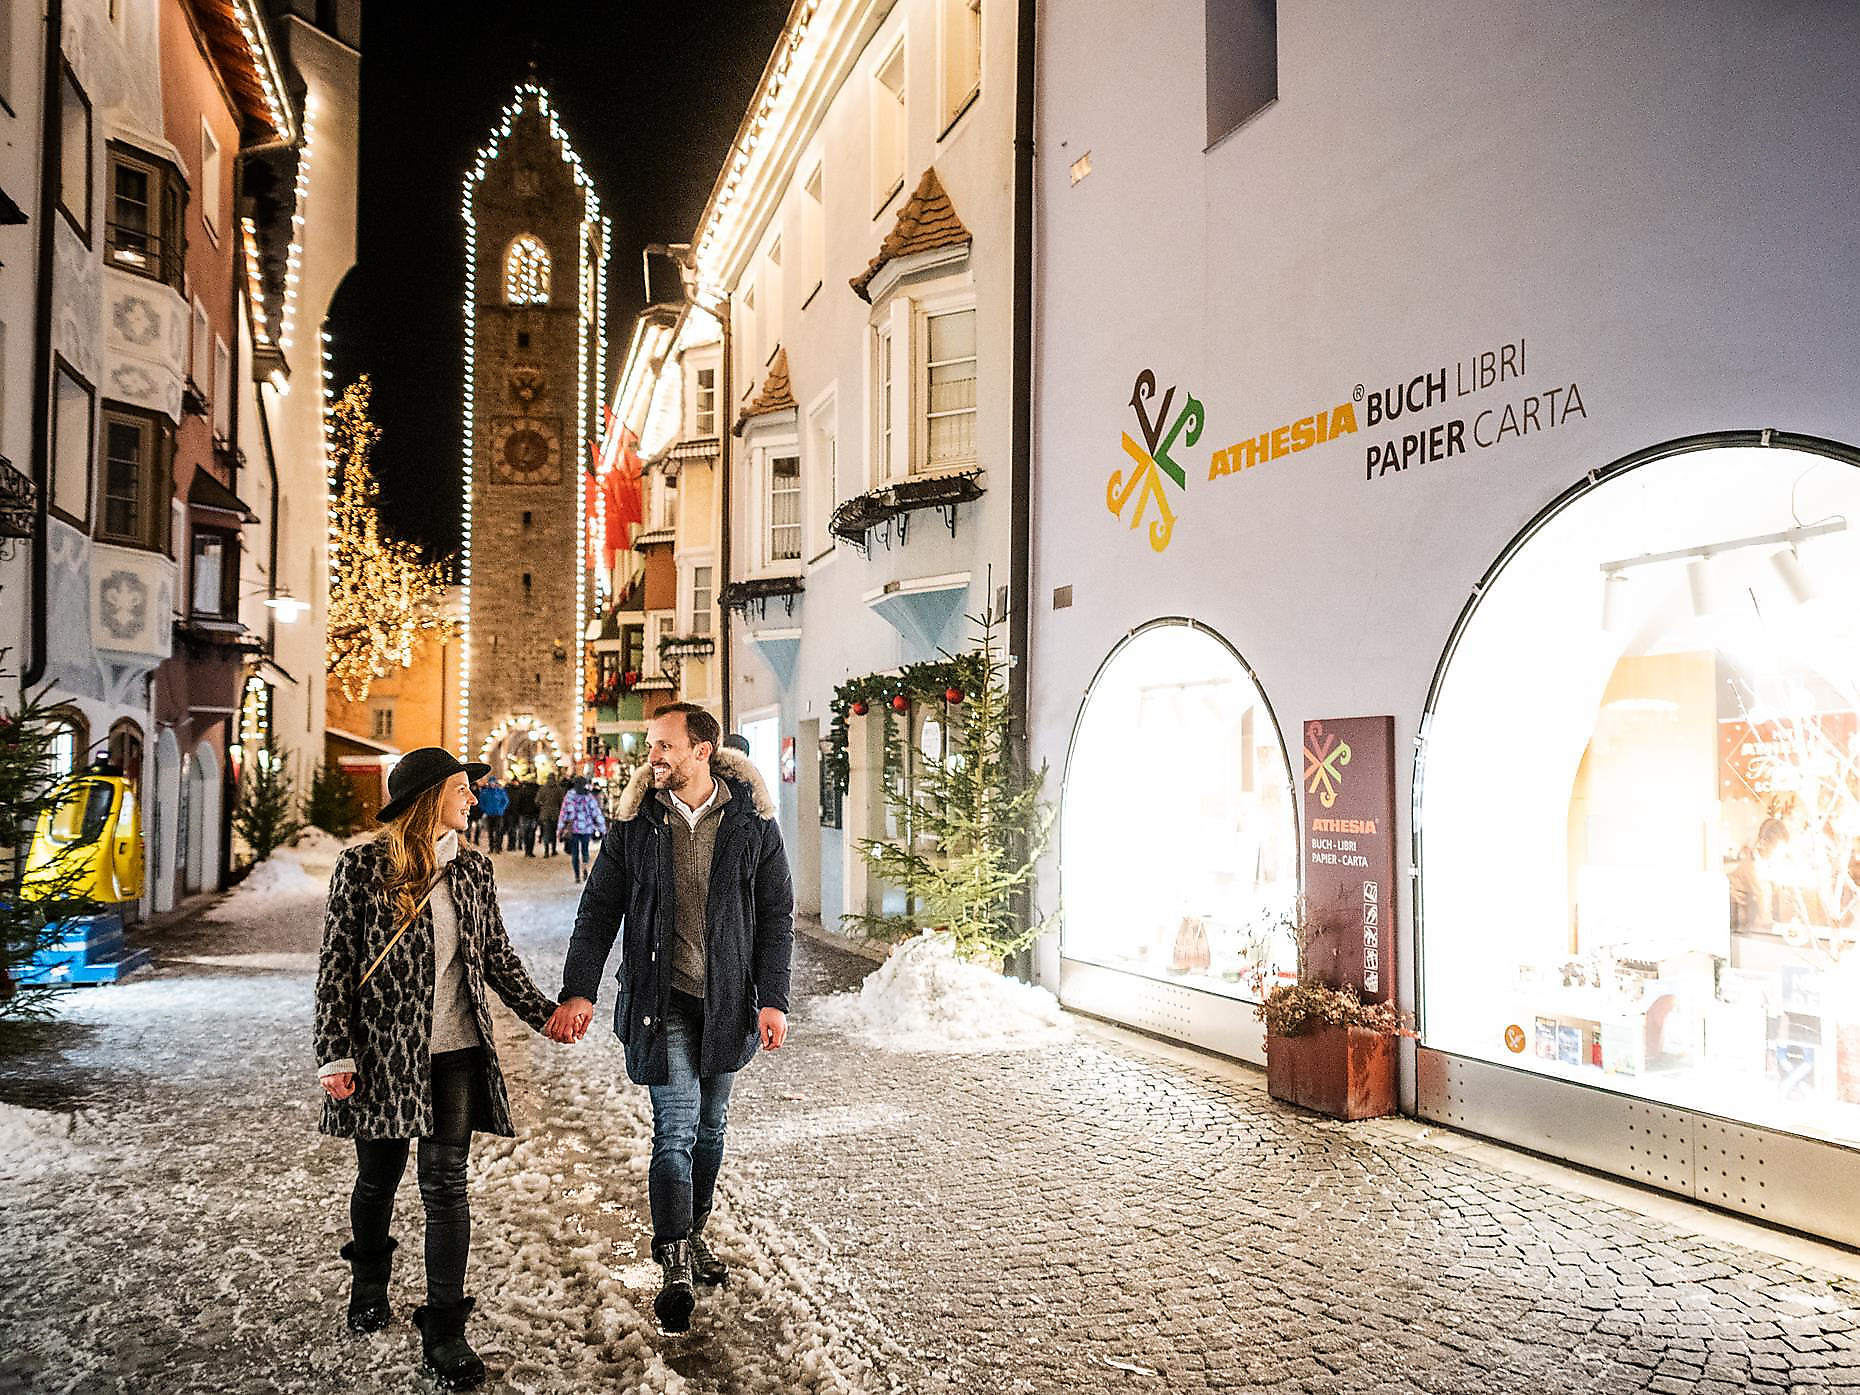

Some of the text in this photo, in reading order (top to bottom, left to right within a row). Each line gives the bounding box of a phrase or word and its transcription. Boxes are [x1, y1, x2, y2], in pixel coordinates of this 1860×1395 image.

[1367, 338, 1526, 427] BUCH LIBRI
[1366, 383, 1587, 480] PAPIER CARTA
